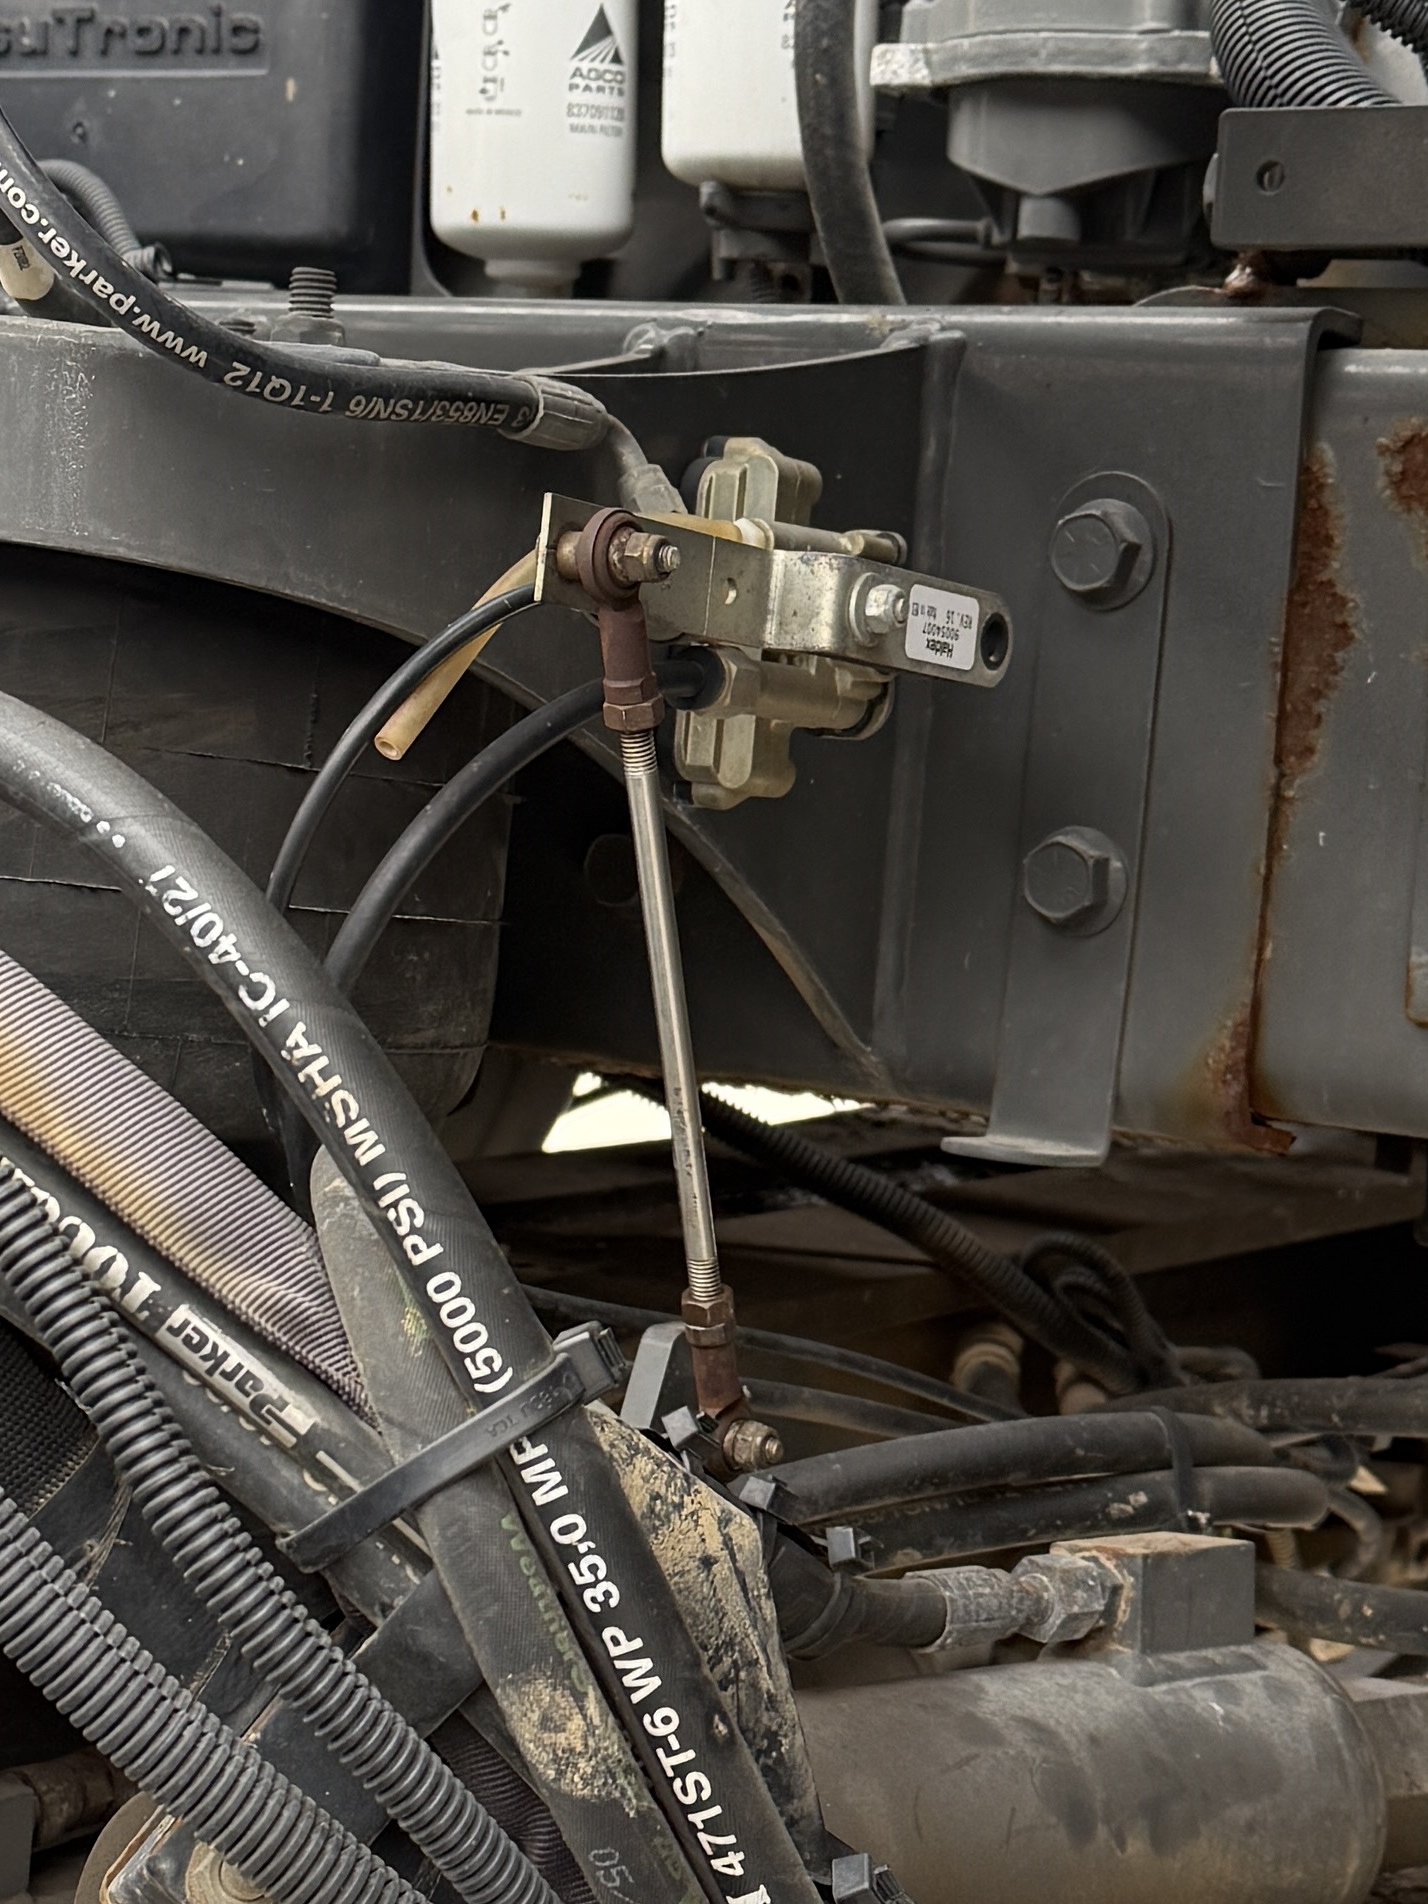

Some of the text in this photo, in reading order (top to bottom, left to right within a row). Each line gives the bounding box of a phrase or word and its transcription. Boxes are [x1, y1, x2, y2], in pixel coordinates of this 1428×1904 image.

[568, 85, 625, 98] PARTS
[569, 67, 626, 84] AGCO
[223, 360, 334, 413] 1-1Q12
[926, 637, 954, 658] Haldex
[282, 1021, 377, 1169] MSHA
[372, 1171, 445, 1268] PSI)
[166, 1308, 314, 1448] Parker
[424, 1270, 514, 1394] (5000
[550, 1504, 622, 1614] 35,0
[600, 1620, 664, 1708] WP
[637, 1703, 747, 1880] 471ST-6
